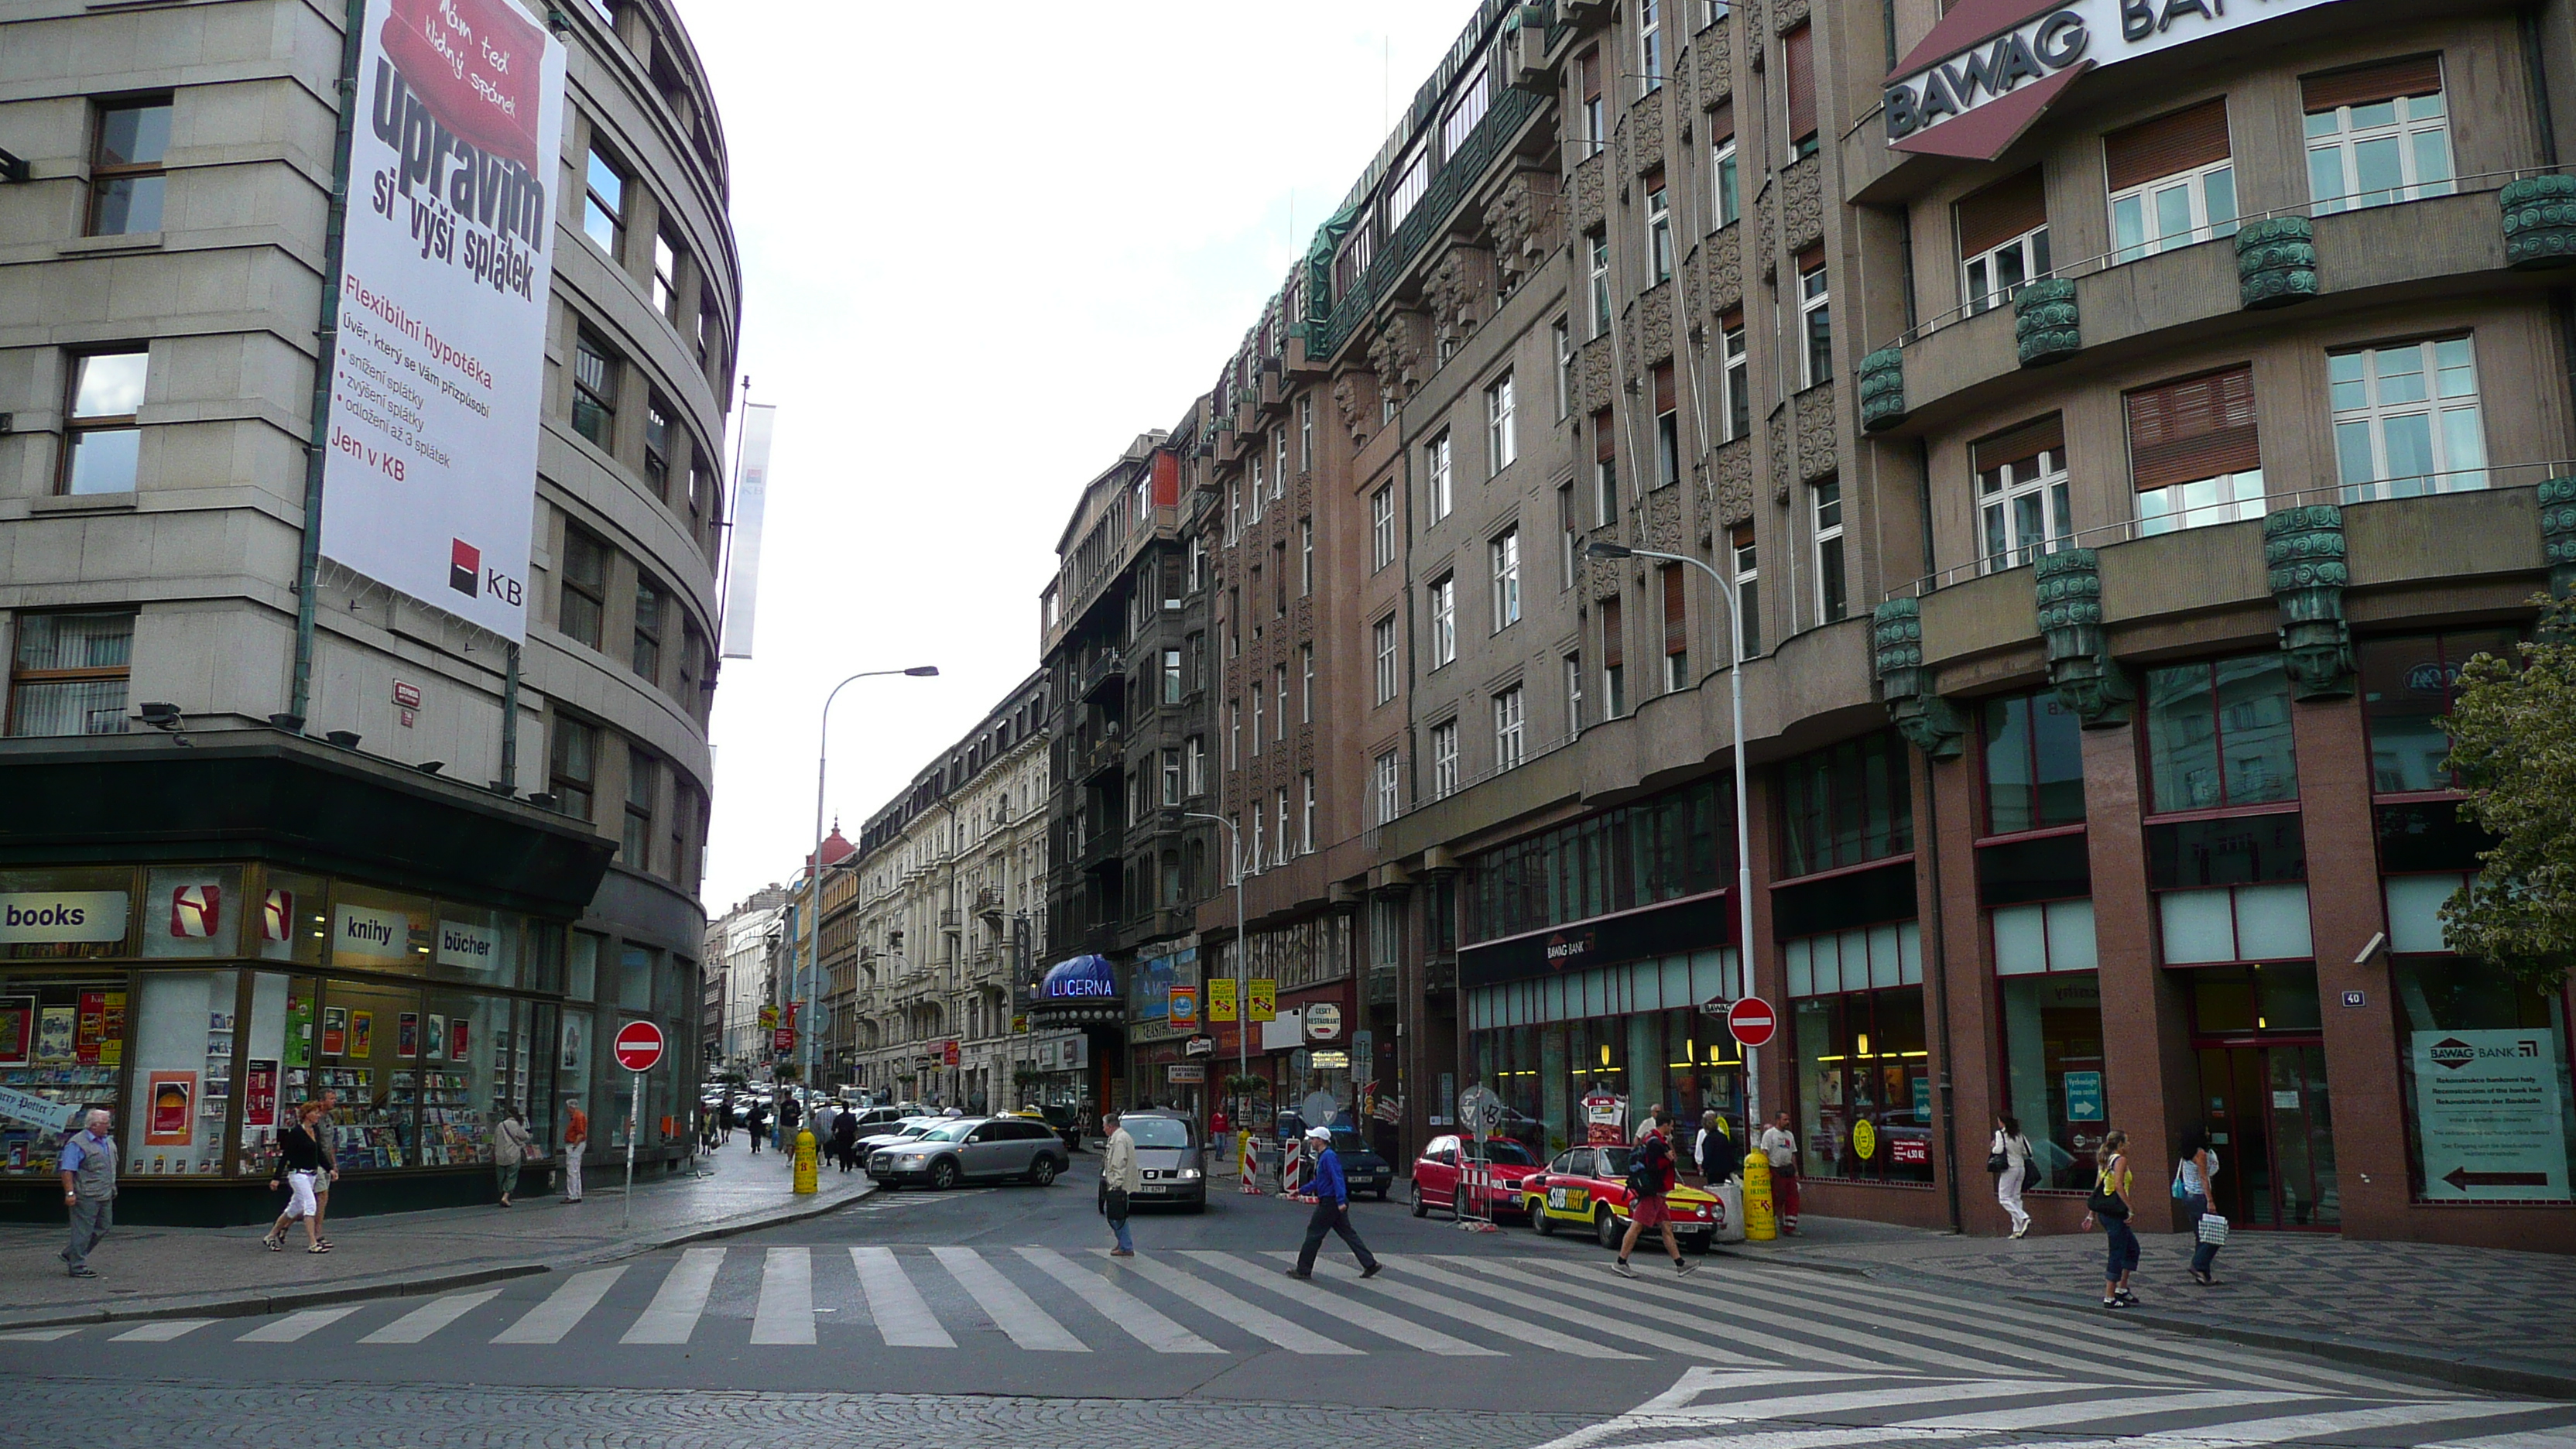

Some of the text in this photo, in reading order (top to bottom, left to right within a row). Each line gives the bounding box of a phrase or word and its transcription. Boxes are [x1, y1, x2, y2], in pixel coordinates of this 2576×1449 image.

[426, 15, 516, 118] klidný spánek
[481, 36, 510, 75] teď
[1885, 9, 2089, 140] BAWAG
[373, 166, 534, 303] si výši splátek
[345, 273, 492, 390] Flexibilní hypotéka
[374, 333, 402, 365] který
[404, 356, 416, 372] se
[418, 361, 440, 387] Vám
[349, 353, 424, 410] snížení splátky
[347, 375, 424, 433] zvýšení splátky
[331, 426, 405, 481] Jen v KB
[345, 399, 450, 469] odložení až 3 splátek
[741, 485, 764, 495] KB
[486, 567, 522, 607] KB
[6, 903, 84, 927] books
[348, 916, 392, 946] knihy
[444, 930, 491, 956] bücher
[1547, 940, 1584, 959] BAWAG BANK
[1052, 979, 1112, 996] LUCERNA
[2348, 993, 2360, 1003] 40
[2430, 1047, 2516, 1059] BAWAG BANK
[17, 1095, 48, 1115] Potter
[1548, 1187, 1589, 1210] SUBWAY
